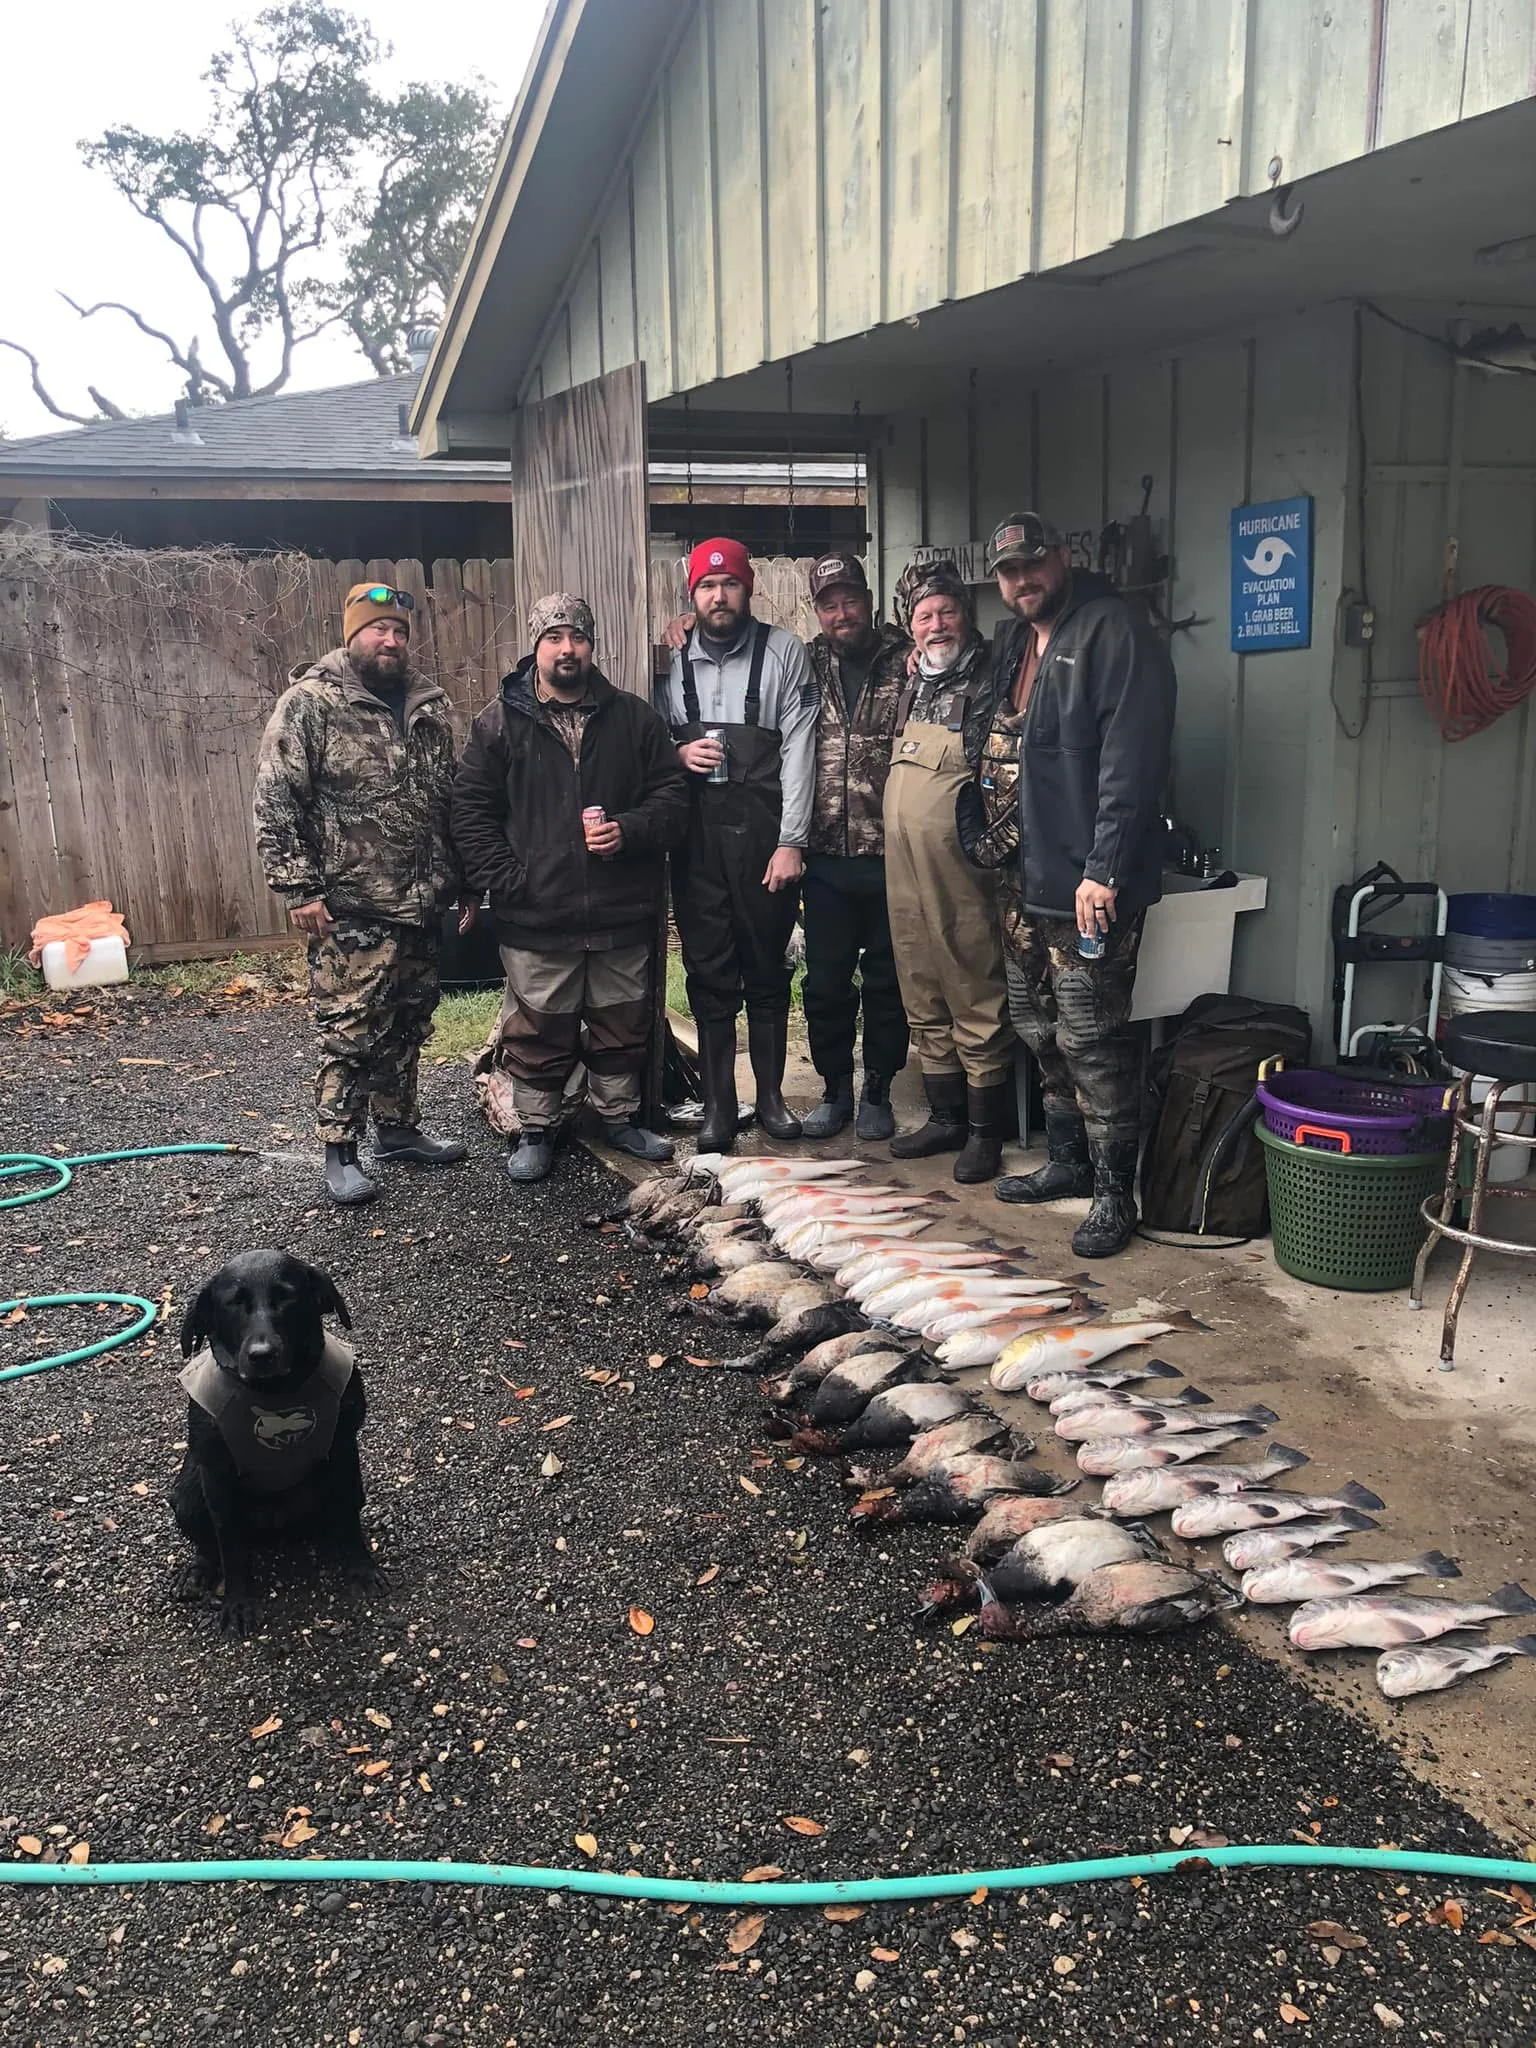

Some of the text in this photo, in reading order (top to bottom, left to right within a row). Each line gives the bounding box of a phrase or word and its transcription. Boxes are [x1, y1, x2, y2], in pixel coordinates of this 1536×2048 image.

[1239, 513, 1300, 536] HURRICANE
[1243, 577, 1295, 594] EVACUATION
[1257, 592, 1280, 606] PLAN
[1244, 607, 1294, 623] 1. GRAB BEER
[1238, 620, 1300, 638] 2. RUN LIKE HELL
